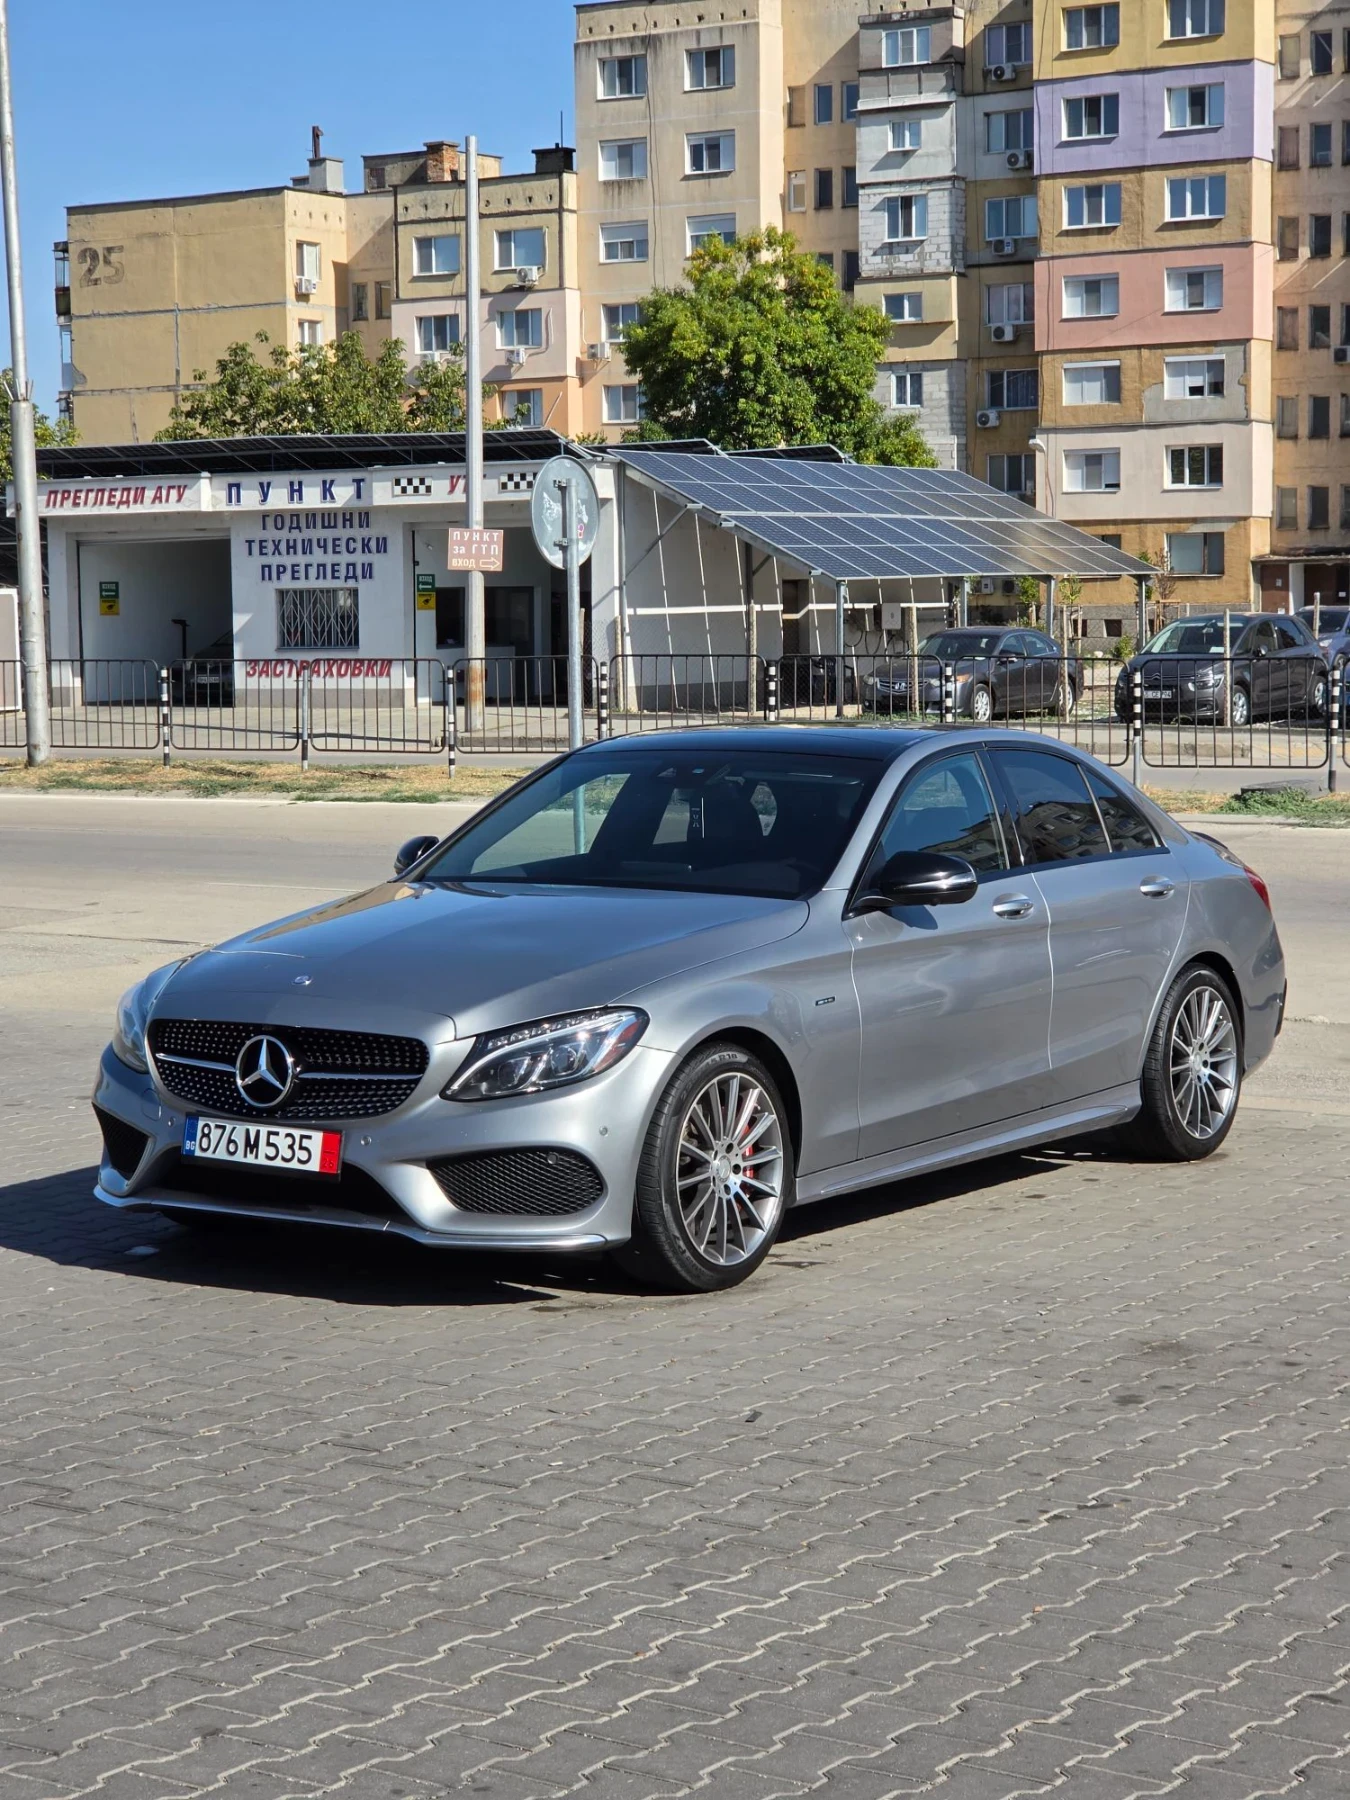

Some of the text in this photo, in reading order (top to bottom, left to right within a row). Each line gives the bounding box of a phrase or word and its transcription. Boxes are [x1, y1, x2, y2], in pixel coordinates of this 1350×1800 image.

[77, 245, 125, 288] 25
[45, 484, 188, 509] ПРЕГЛЕДИ АГУ
[226, 477, 367, 506] ПУНКТ
[261, 510, 371, 533] ГОДИШНИ
[245, 535, 389, 557] ТЕХНИЧЕСКИ
[452, 531, 500, 542] ПУНКТ
[452, 543, 499, 555] за ГТП
[260, 562, 375, 583] ПРЕГЛЕДИ
[452, 557, 476, 569] ВХОД
[245, 659, 394, 679] ЗАСТРАХОВКИ
[185, 1122, 314, 1165] BG 876 M 535
